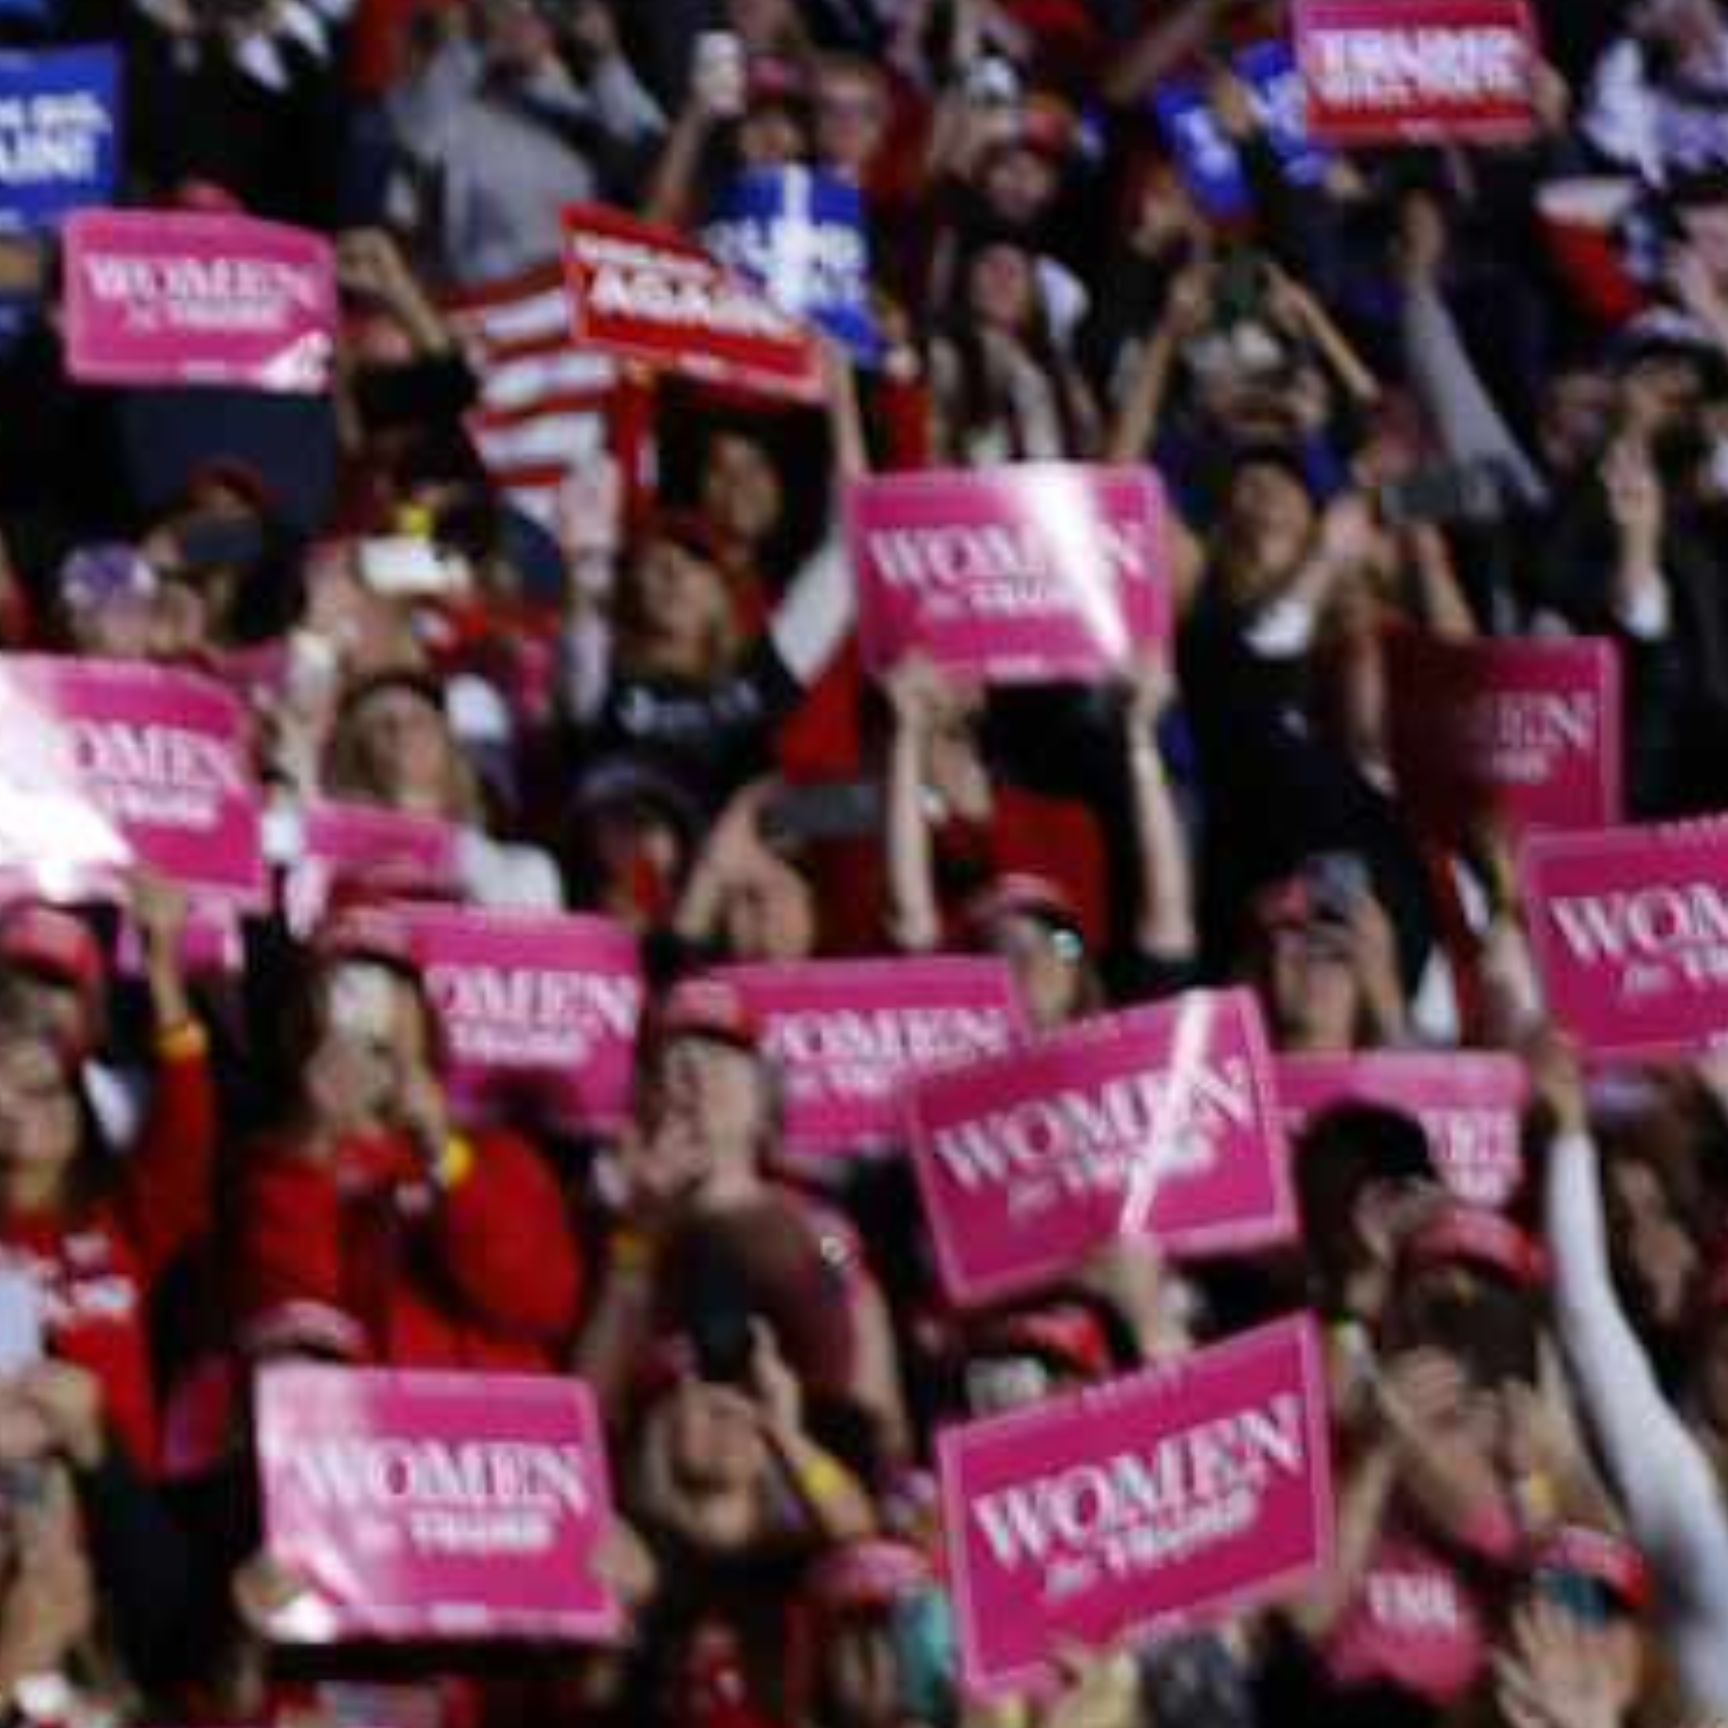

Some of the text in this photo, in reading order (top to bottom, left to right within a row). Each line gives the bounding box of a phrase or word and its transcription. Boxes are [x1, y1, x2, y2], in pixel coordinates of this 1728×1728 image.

[82, 250, 316, 310] WOMEN
[866, 521, 1152, 590] WOMN
[66, 718, 244, 796] OMEN
[1548, 880, 1728, 966] WOM
[932, 1056, 1258, 1196] WOMEN
[292, 1438, 590, 1512] WOMEN
[972, 1390, 1308, 1570] WOMEN
